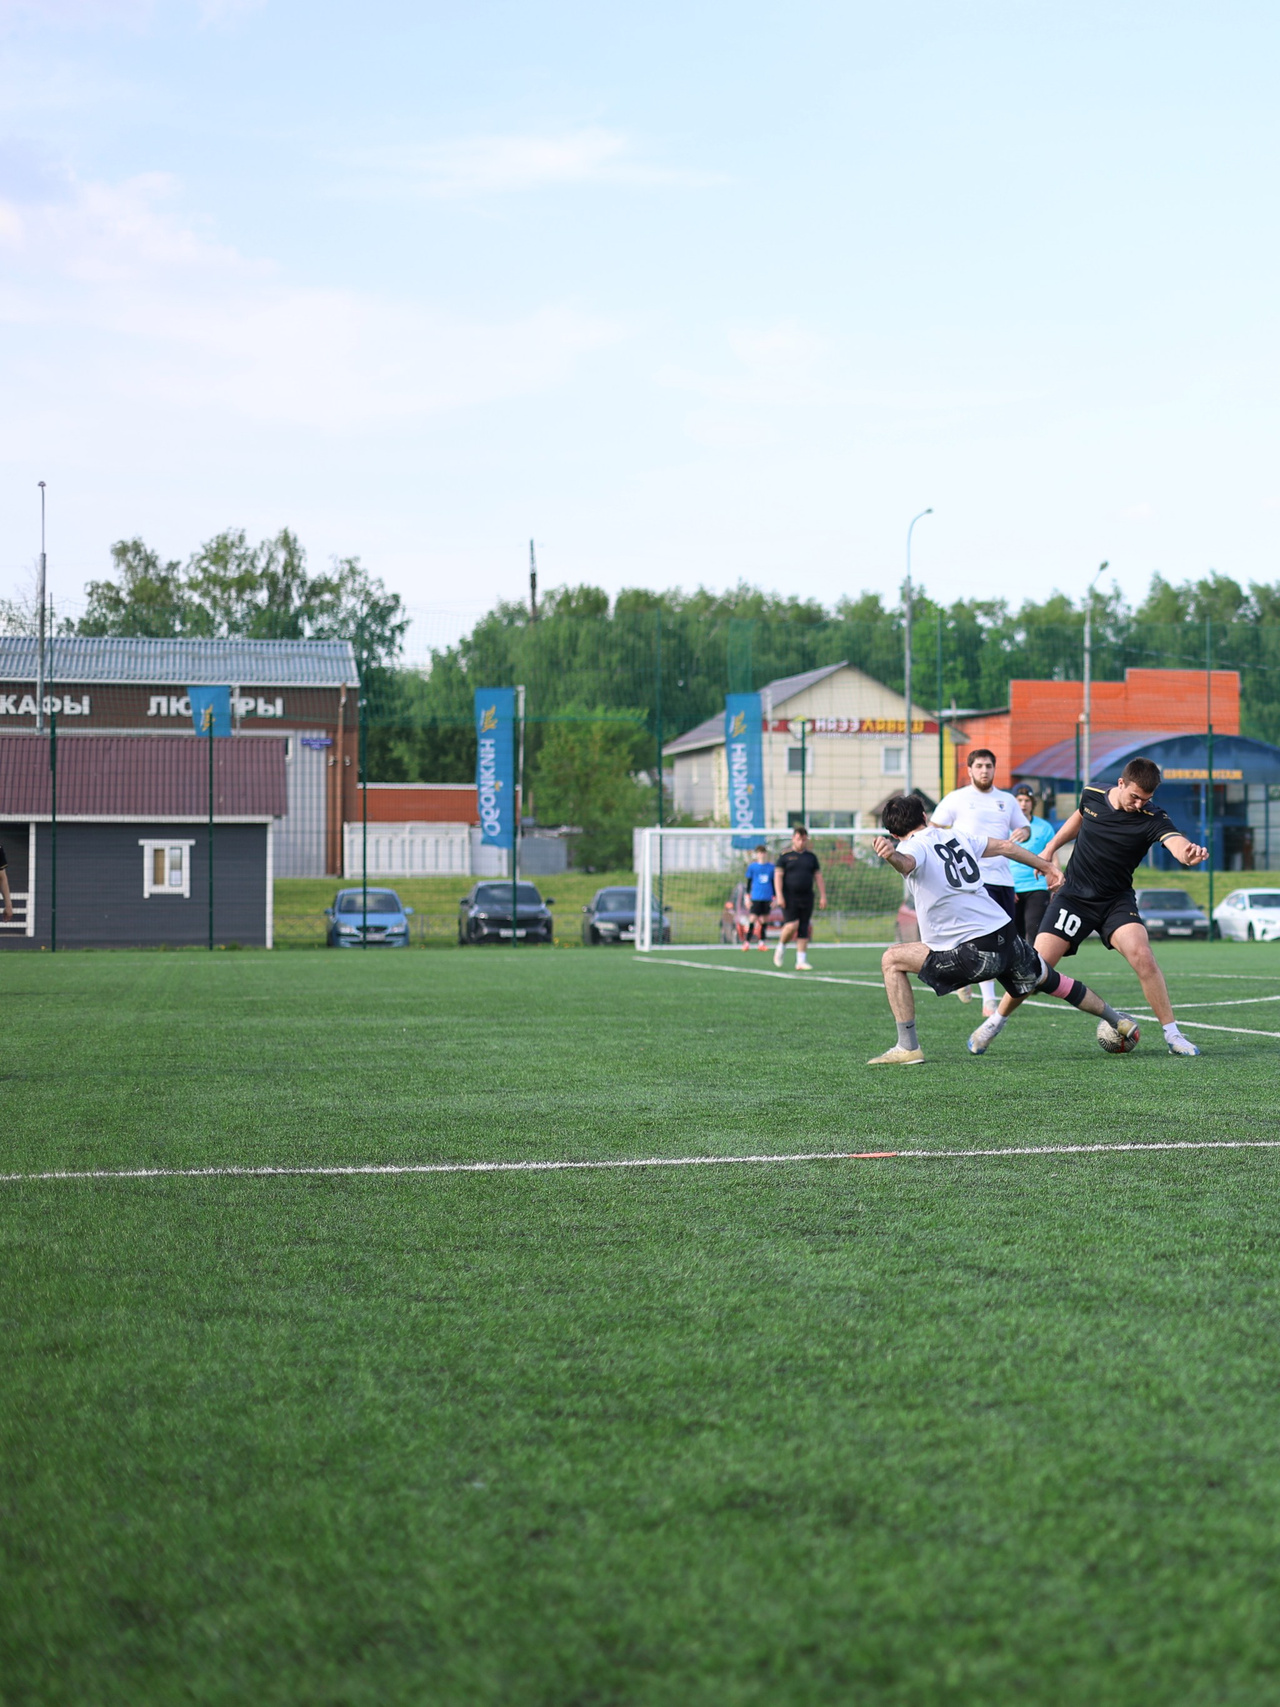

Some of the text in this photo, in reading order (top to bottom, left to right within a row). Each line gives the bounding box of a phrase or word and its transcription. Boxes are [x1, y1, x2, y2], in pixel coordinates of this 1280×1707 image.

[147, 695, 284, 717] ЛЮРЫ
[934, 838, 980, 888] 85
[1054, 908, 1082, 938] 10
